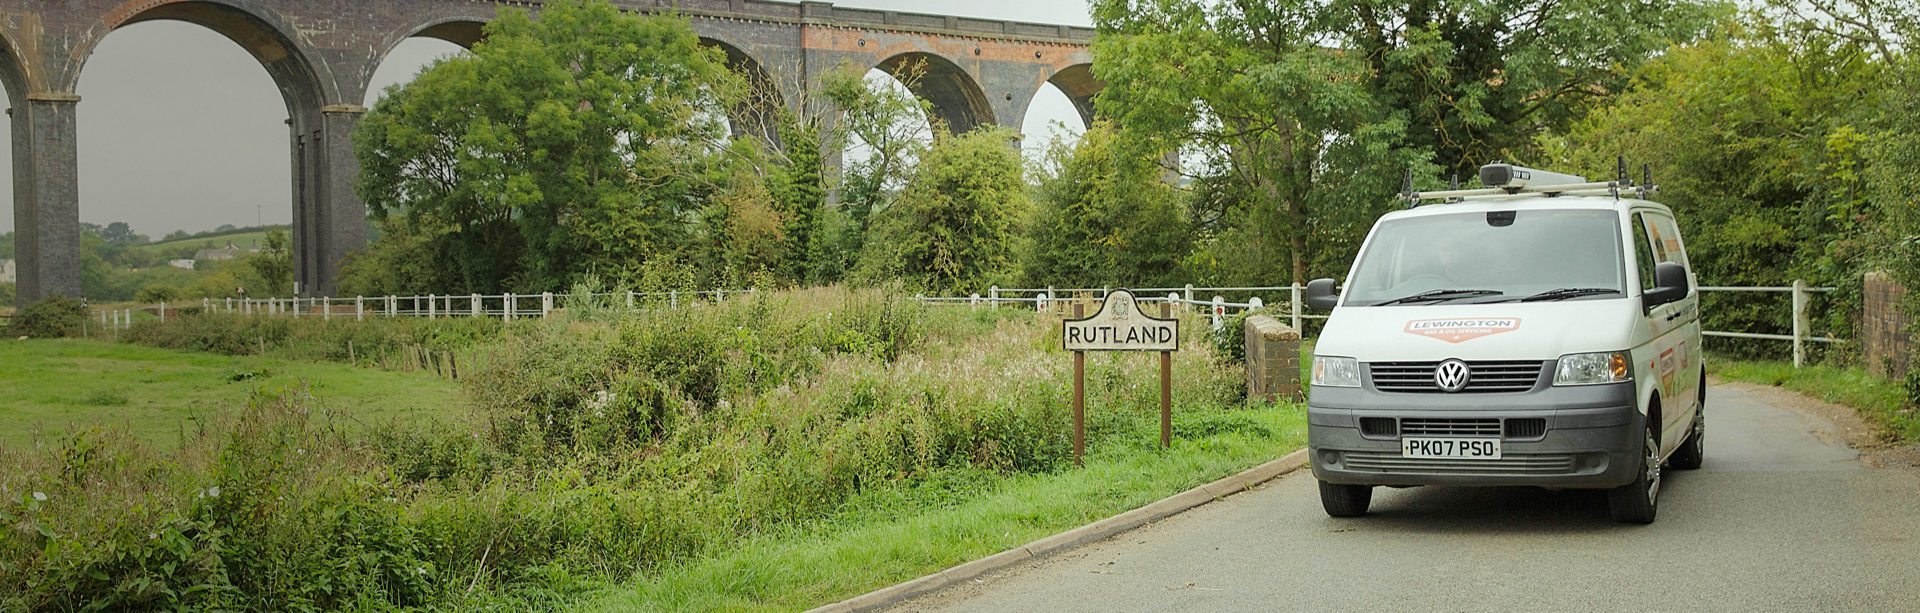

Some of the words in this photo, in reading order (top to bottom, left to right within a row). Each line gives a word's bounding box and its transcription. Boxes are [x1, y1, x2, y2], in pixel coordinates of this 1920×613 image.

[1413, 320, 1511, 328] LEWINGTON
[1069, 326, 1172, 344] RUTLAND
[1410, 440, 1453, 455] PK07
[1460, 441, 1493, 456] PSO
